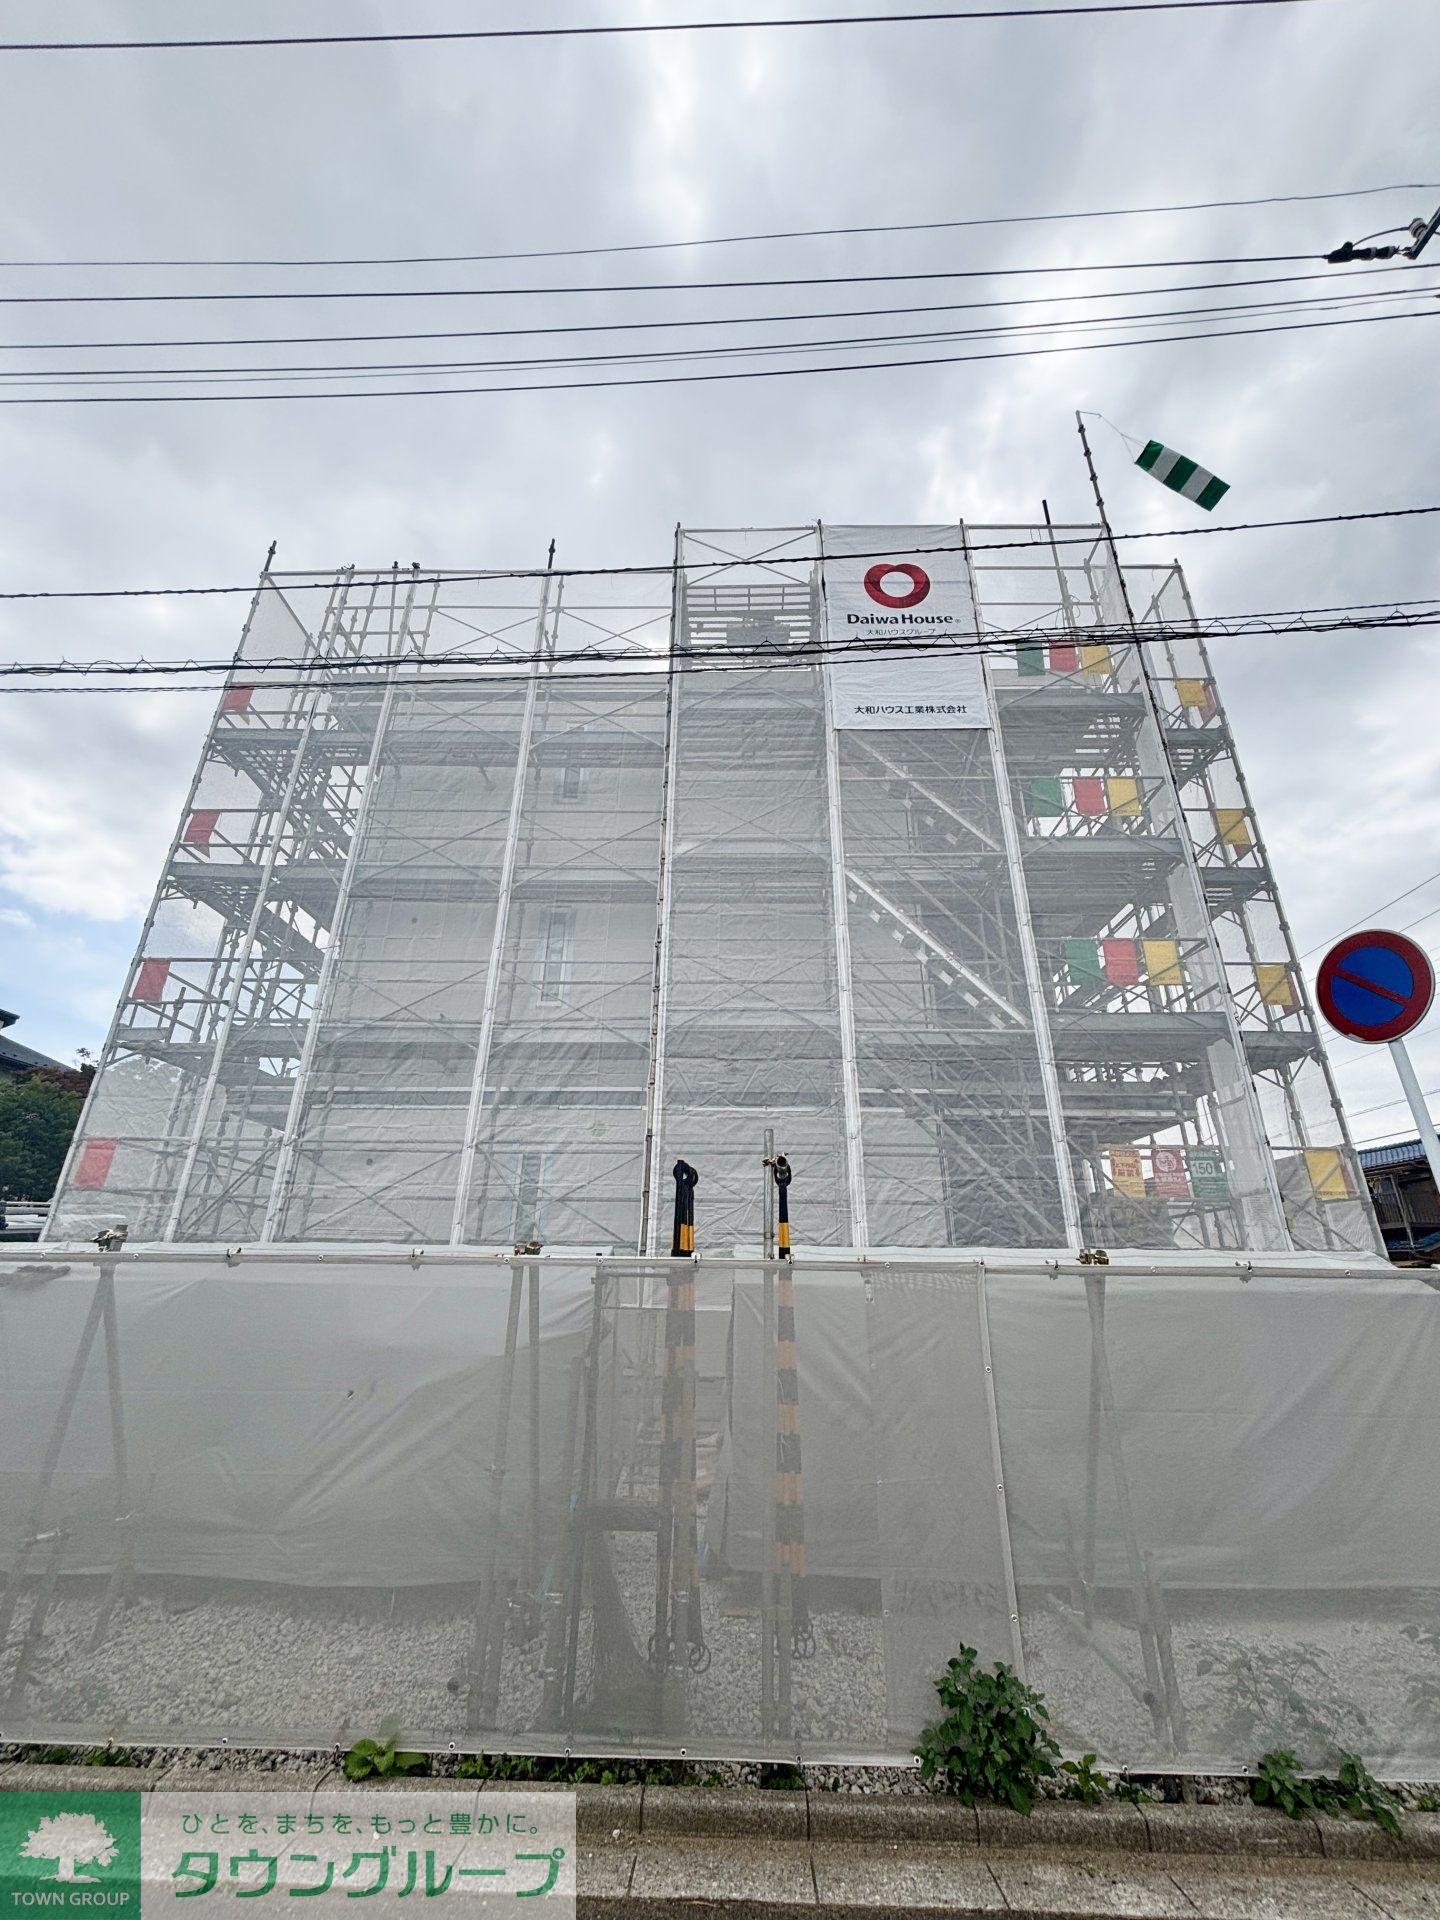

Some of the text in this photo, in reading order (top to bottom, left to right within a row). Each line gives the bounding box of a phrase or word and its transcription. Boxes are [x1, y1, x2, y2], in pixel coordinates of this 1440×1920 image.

[847, 613, 953, 625] Daiwa House
[866, 628, 936, 636] 大和ハウスグループ
[854, 705, 968, 715] 大和ハウス工業株式会社
